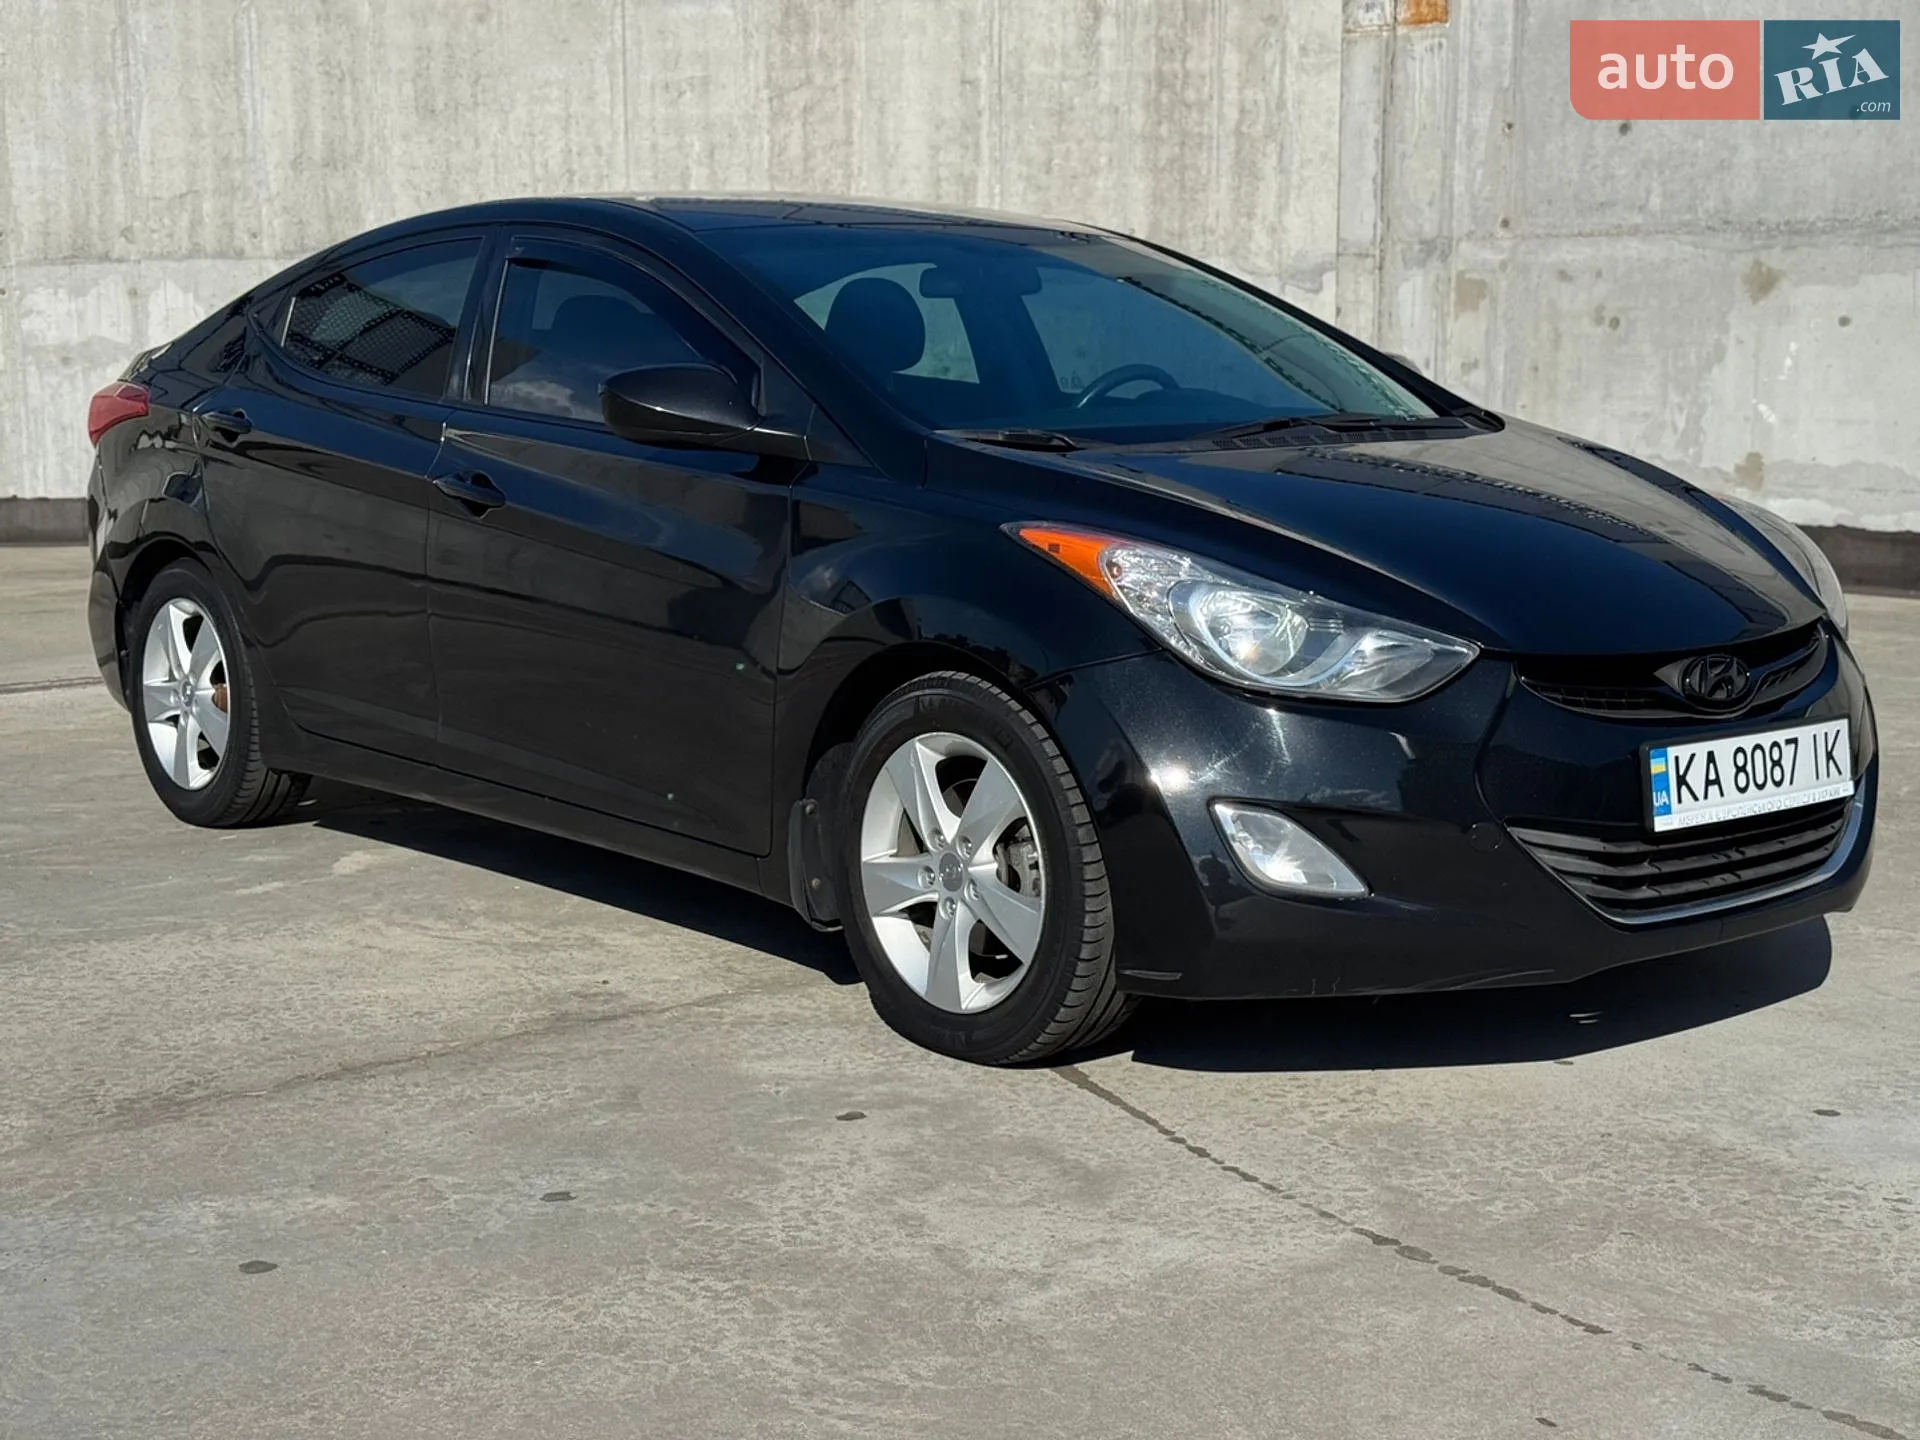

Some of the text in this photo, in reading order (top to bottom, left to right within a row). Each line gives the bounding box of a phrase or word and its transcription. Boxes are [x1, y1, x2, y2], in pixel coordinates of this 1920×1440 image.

[1674, 728, 1843, 804] KA 8087 IK
[1653, 790, 1670, 807] UA
